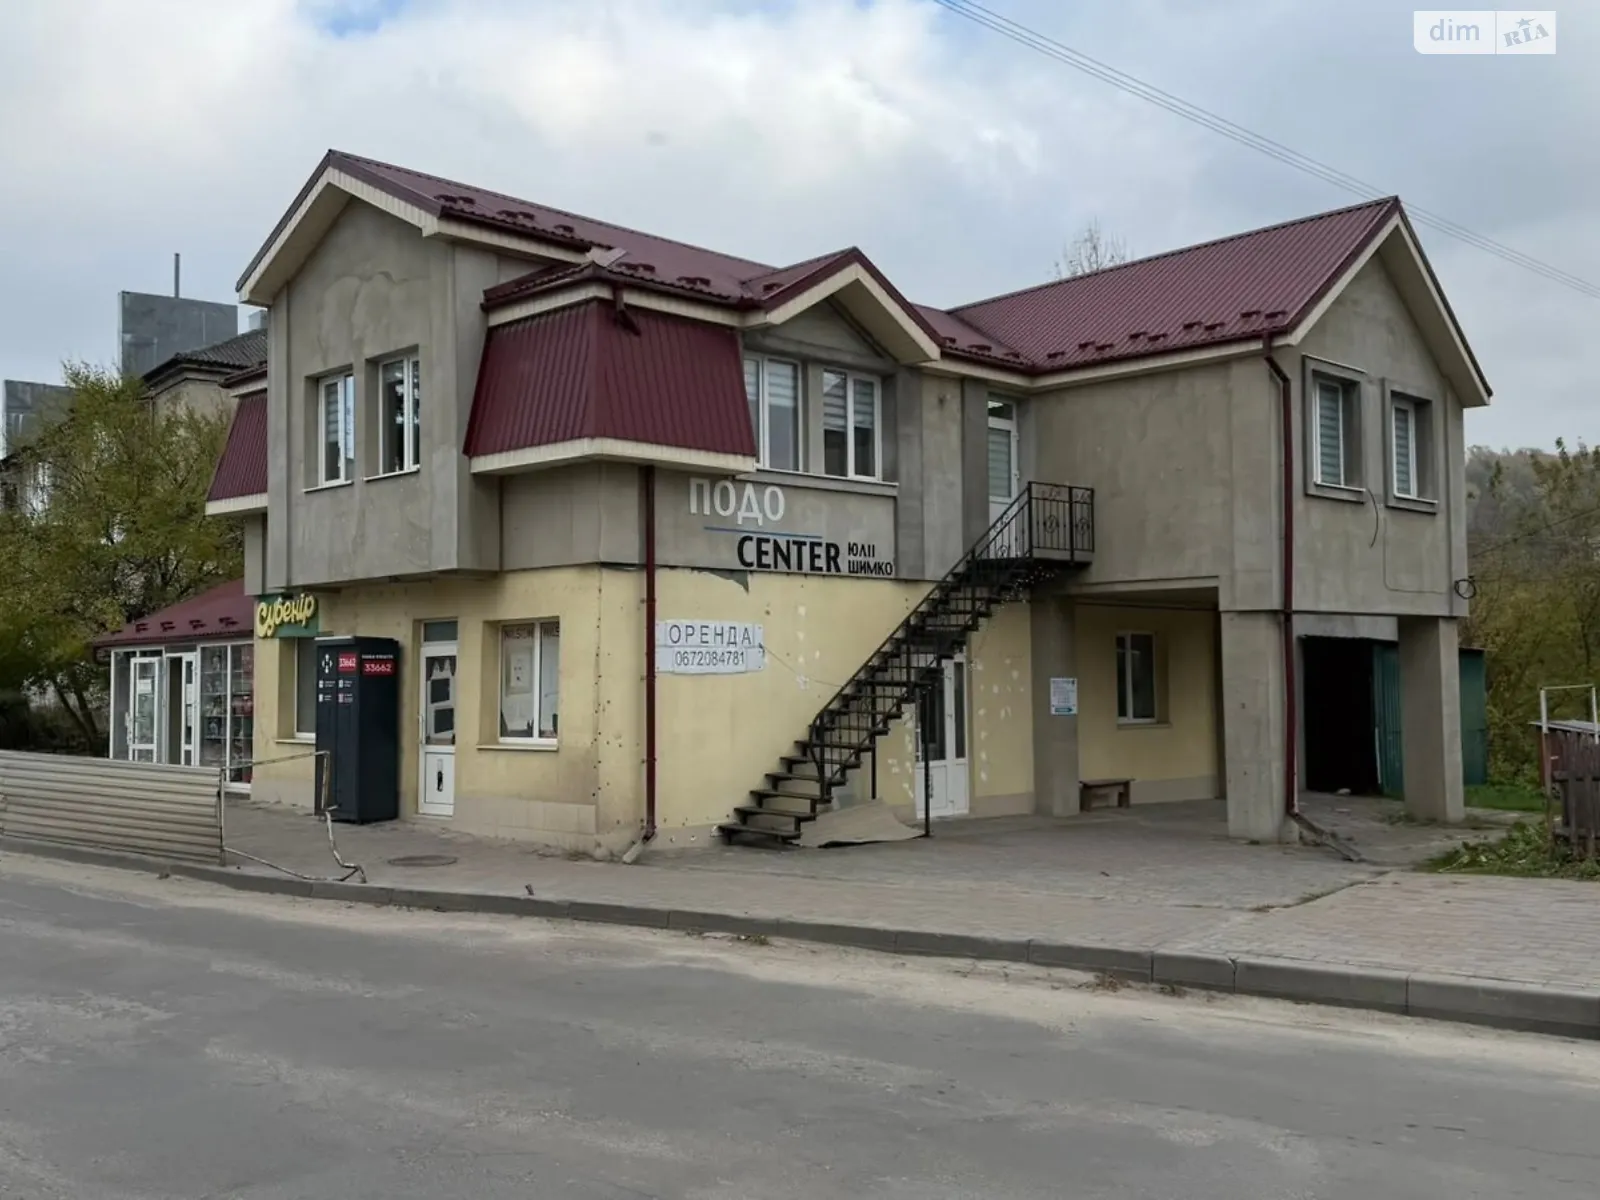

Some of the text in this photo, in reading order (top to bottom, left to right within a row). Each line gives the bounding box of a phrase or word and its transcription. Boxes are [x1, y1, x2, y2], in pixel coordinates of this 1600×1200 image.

[689, 477, 786, 526] ПОДО
[737, 535, 842, 573] CENTER
[847, 559, 893, 576] ШИМКО
[256, 592, 315, 638] Сувенір
[669, 624, 752, 647] ОРЕНДА
[675, 651, 744, 666] 0672084781
